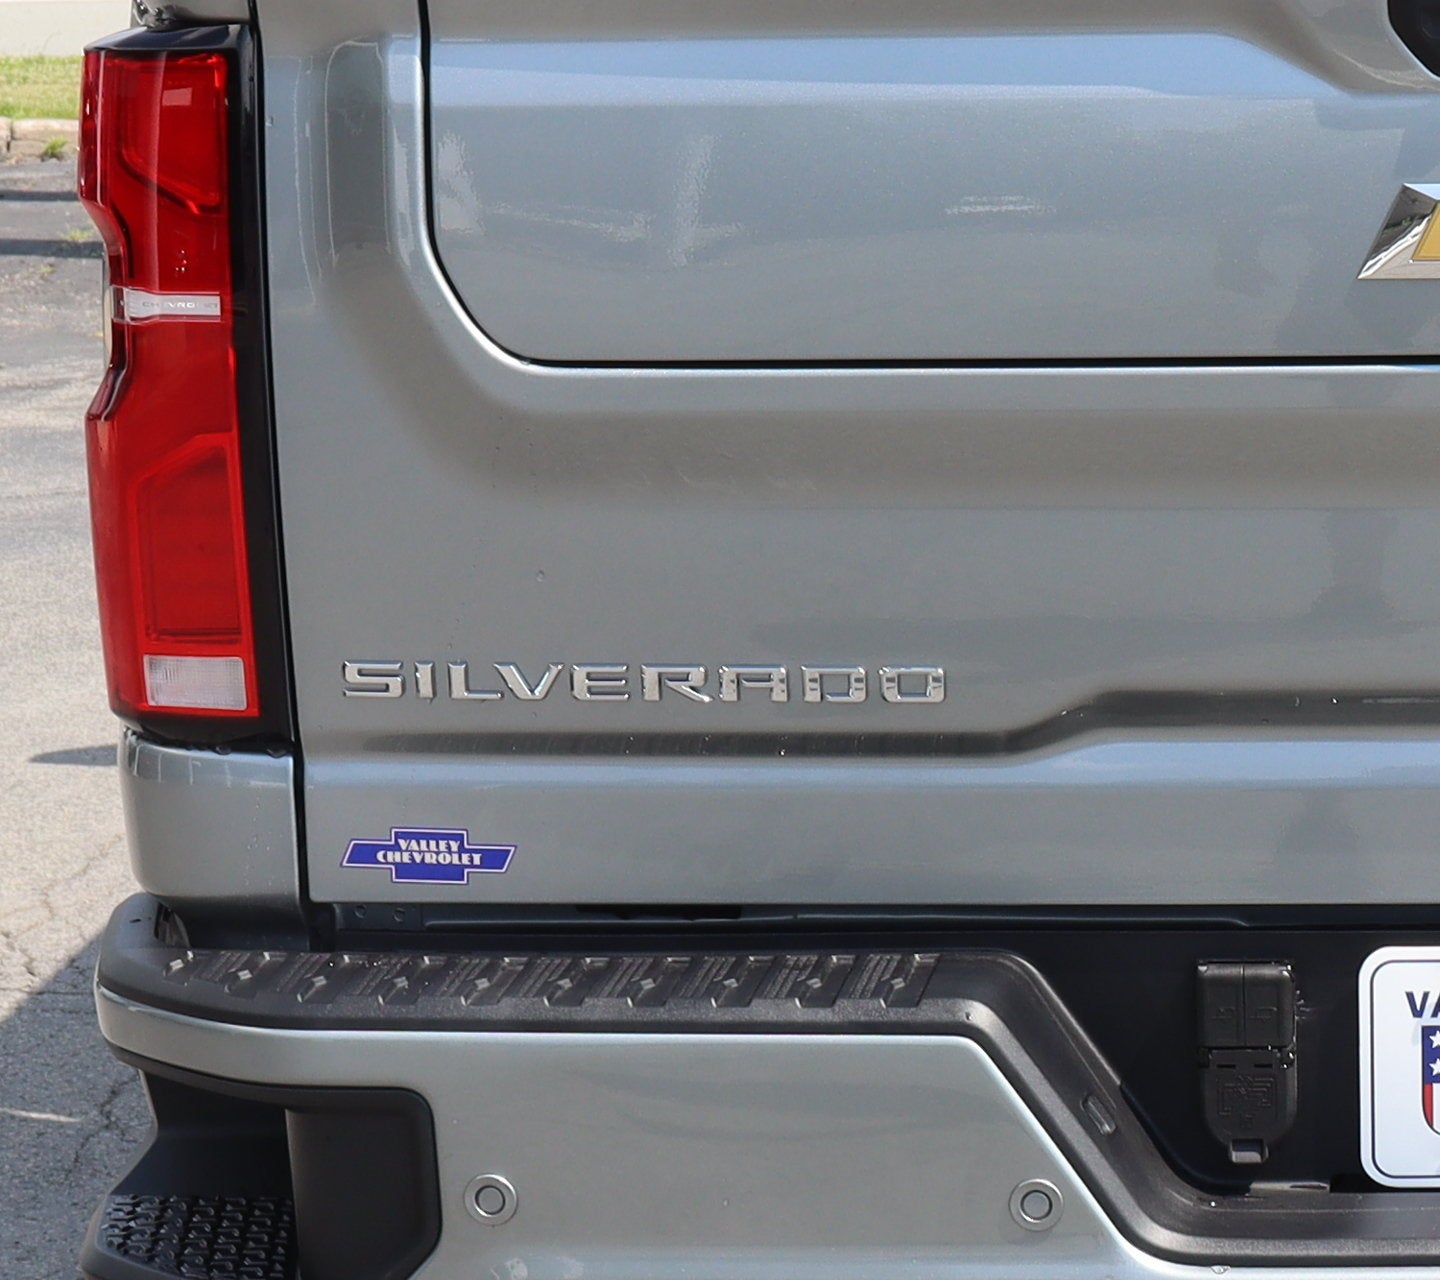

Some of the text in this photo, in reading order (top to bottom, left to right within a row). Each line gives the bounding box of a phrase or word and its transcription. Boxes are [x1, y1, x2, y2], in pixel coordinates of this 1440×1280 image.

[342, 660, 947, 704] SILVERADO
[397, 838, 461, 852] VALLEY
[376, 850, 482, 866] CHEVROLET
